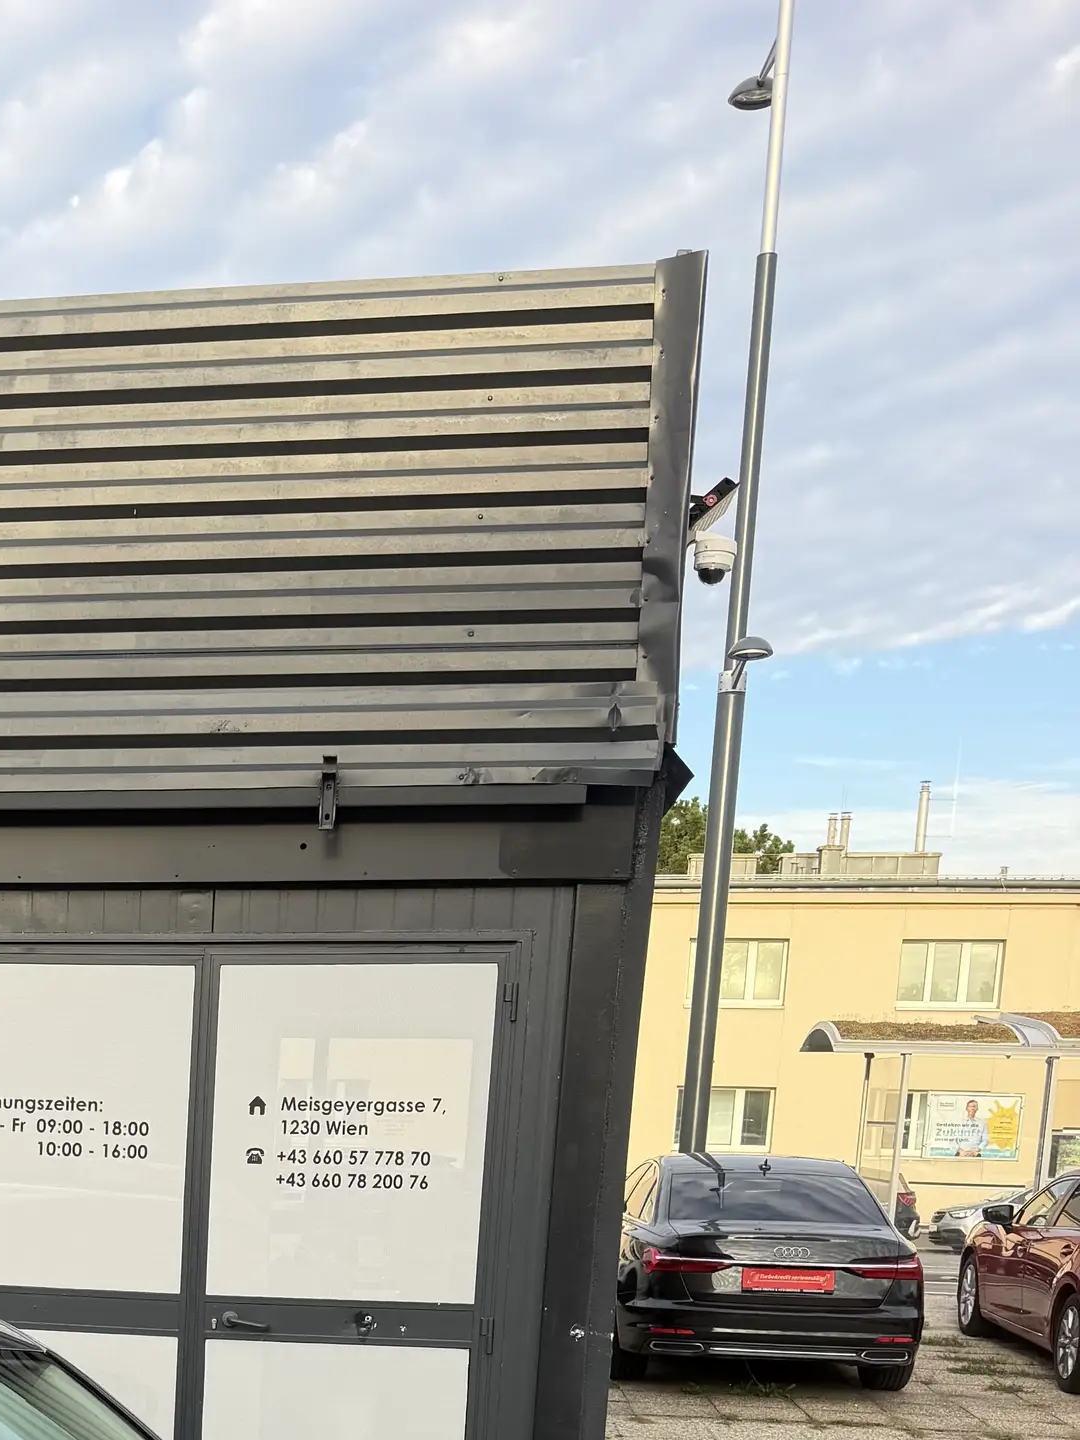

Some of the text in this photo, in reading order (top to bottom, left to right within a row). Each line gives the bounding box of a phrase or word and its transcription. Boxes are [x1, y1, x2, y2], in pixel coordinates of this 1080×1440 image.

[280, 1096, 446, 1117] Meisgeyergasse 7,
[12, 1117, 27, 1133] Fr
[36, 1118, 83, 1135] 09:00
[103, 1120, 150, 1137] 18:00
[281, 1119, 321, 1136] 1230
[325, 1120, 368, 1136] Wien
[37, 1141, 83, 1157] 10:00
[102, 1143, 148, 1160] 16:00
[276, 1149, 431, 1167] +43 660 57 778 70
[275, 1172, 429, 1190] +43 660 78 200 76
